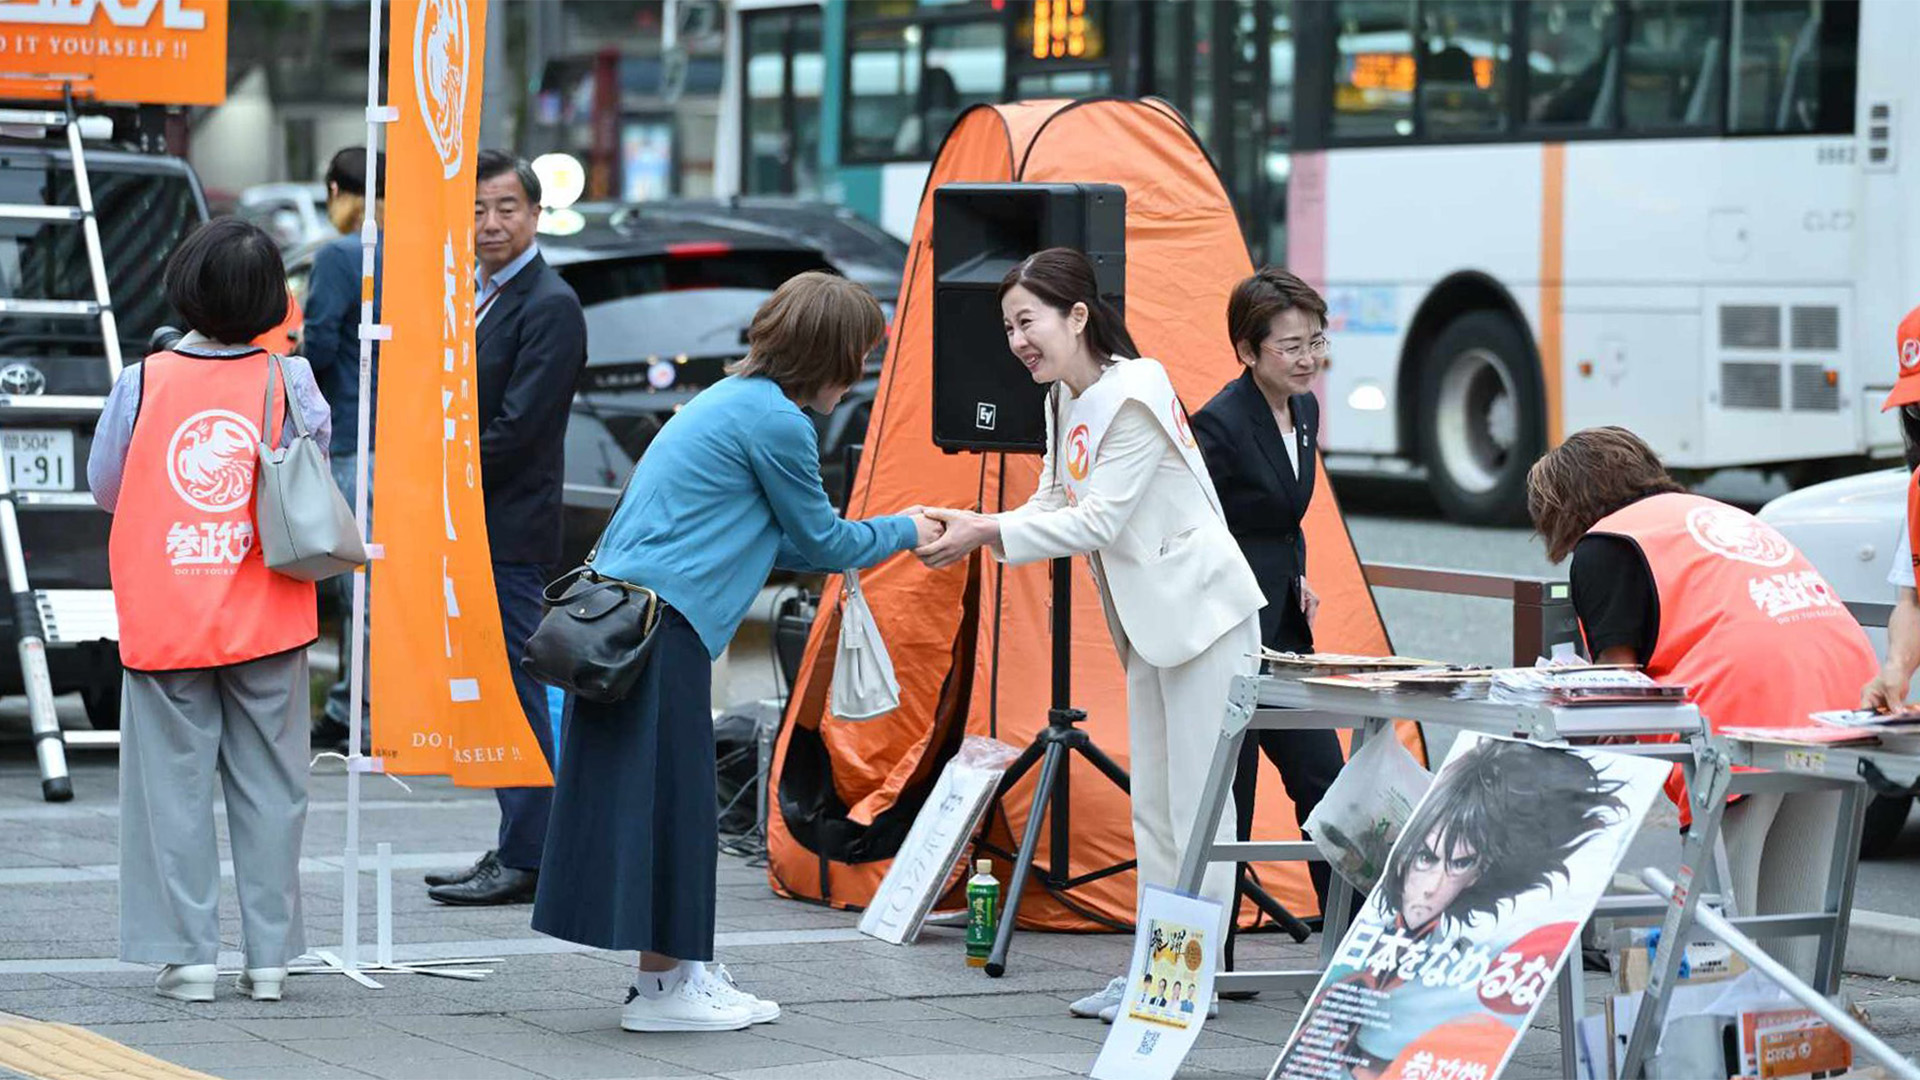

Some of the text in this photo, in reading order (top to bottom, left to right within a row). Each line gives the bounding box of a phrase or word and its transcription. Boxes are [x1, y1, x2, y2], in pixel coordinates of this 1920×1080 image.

[15, 35, 40, 54] IT
[50, 37, 165, 58] YOURSELF
[166, 521, 254, 566] 参政党
[1748, 570, 1841, 618] 参政党
[413, 733, 442, 748] DO
[1341, 923, 1553, 1006] 日本をなめるな
